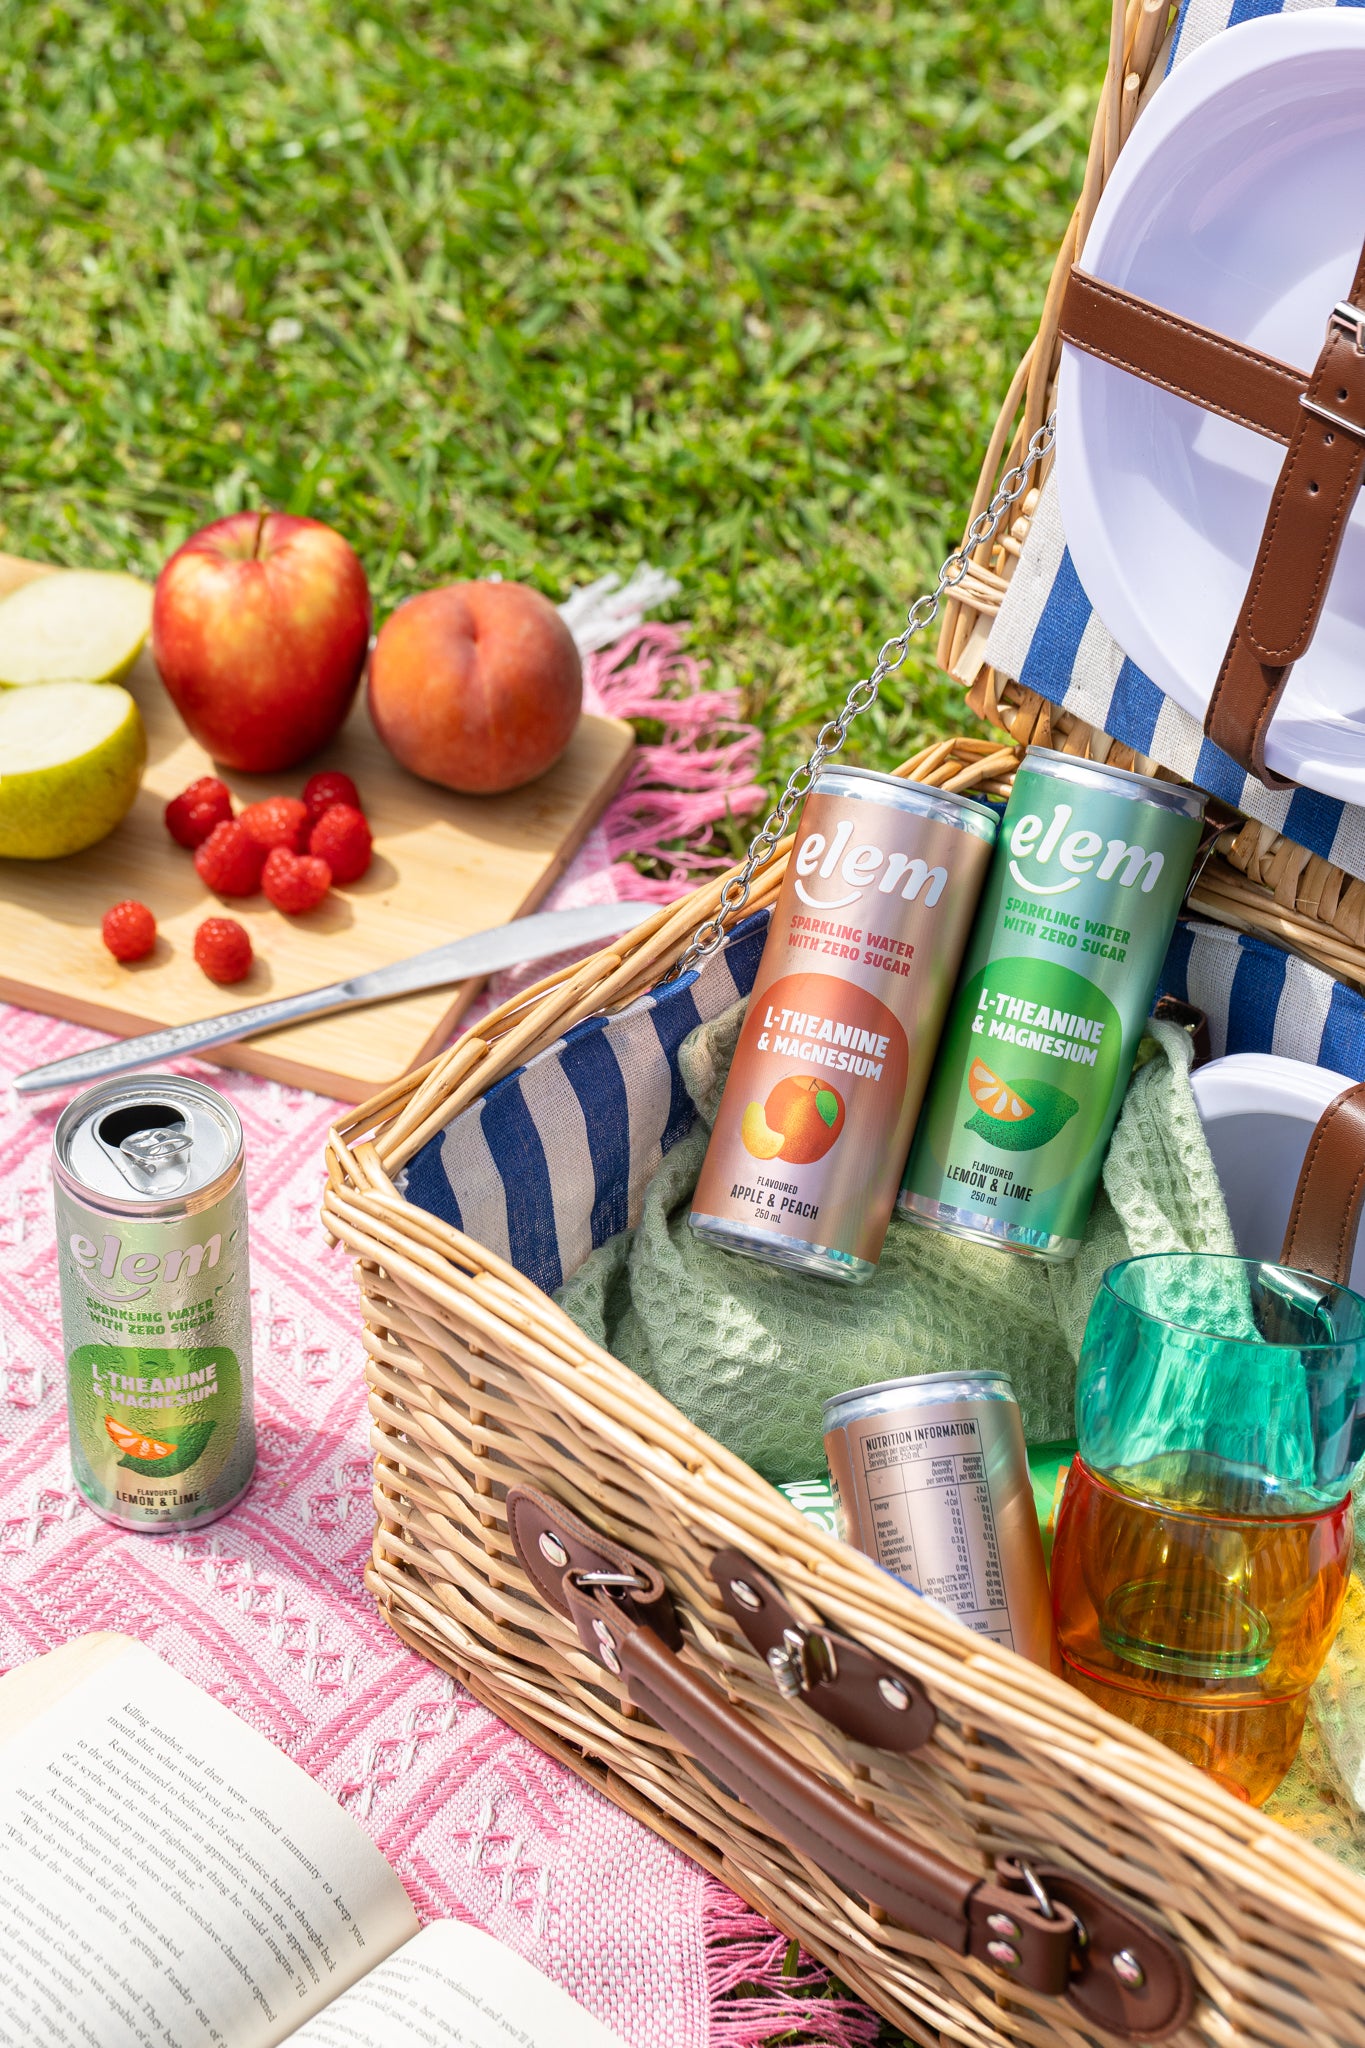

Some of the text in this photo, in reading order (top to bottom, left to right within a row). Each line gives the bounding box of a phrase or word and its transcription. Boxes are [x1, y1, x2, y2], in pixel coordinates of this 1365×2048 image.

[796, 821, 948, 907] elem
[1010, 804, 1164, 892] elem
[791, 915, 914, 959] SPARKLING WATER
[1004, 915, 1126, 963] WITH ZERO SUGAR
[1006, 897, 1130, 945] SPARKLING WATER
[788, 933, 910, 977] WITH ZERO SUGAR
[763, 1006, 890, 1059] L-THEANINE
[977, 988, 1104, 1044] L-THEANINE
[757, 1033, 883, 1081] & MAGNESIUM
[971, 1015, 1098, 1066] & MAGNESIUM
[757, 1176, 798, 1195] FLAVOURED
[947, 1165, 1033, 1202] LEMON & LIME
[972, 1161, 1013, 1180] FLAVOURED
[730, 1184, 819, 1219] APPLE & PEACH
[755, 1208, 781, 1223] 250 mL
[971, 1190, 997, 1206] 250 mL
[70, 1233, 222, 1284] elem
[86, 1297, 213, 1322] SPARKLING WATER
[89, 1312, 215, 1335] WITH ZERO SUGAR
[92, 1363, 217, 1392] L-THEANINE
[93, 1382, 218, 1408] & MAGNESIUM
[866, 1423, 976, 1451] NUTRITION INFORMATION
[932, 1459, 952, 1467] Average
[932, 1466, 953, 1475] Quantity
[963, 1456, 981, 1464] Average
[963, 1464, 982, 1472] Quantity
[936, 1475, 954, 1483] serving
[116, 1491, 200, 1506] LEMON & LIME
[874, 1502, 889, 1511] Energy
[877, 1520, 893, 1529] Protein
[881, 1545, 912, 1557] Carbohydrate
[107, 1716, 136, 1739] mouth
[135, 1737, 154, 1755] shut,
[156, 1753, 177, 1772] what
[178, 1770, 206, 1793] would
[201, 1791, 220, 1807] you
[47, 1762, 62, 1776] kiss
[63, 1775, 77, 1789] the
[77, 1788, 96, 1805] ring
[95, 1803, 114, 1816] and
[112, 1813, 132, 1833] keep
[132, 1831, 148, 1844] my
[147, 1844, 176, 1870] mouth
[123, 1703, 365, 1947] killing another, and then were offered immunity to keep your
[62, 1753, 77, 1762] of
[79, 1765, 106, 1786] scythe
[107, 1786, 123, 1800] was
[123, 1800, 138, 1812] the
[137, 1811, 159, 1831] most
[160, 1828, 206, 1872] frightening
[206, 1869, 230, 1896] thing
[229, 1892, 242, 1908] he
[242, 1908, 268, 1936] could
[265, 1935, 294, 1979] imagine.
[77, 1740, 320, 1984] to the days before he became an apprentice, when the appearance
[109, 1739, 139, 1766] Rowan
[139, 1763, 172, 1789] wanted
[168, 1786, 177, 1796] to
[177, 1793, 207, 1819] believe
[224, 1835, 244, 1854] seek
[239, 1851, 269, 1884] justice,
[270, 1879, 286, 1898] but
[284, 1894, 296, 1910] he
[295, 1910, 323, 1949] thought
[321, 1946, 337, 1972] back
[47, 1788, 277, 2023] Across the rotunda, the doors of the conclave chamber opened
